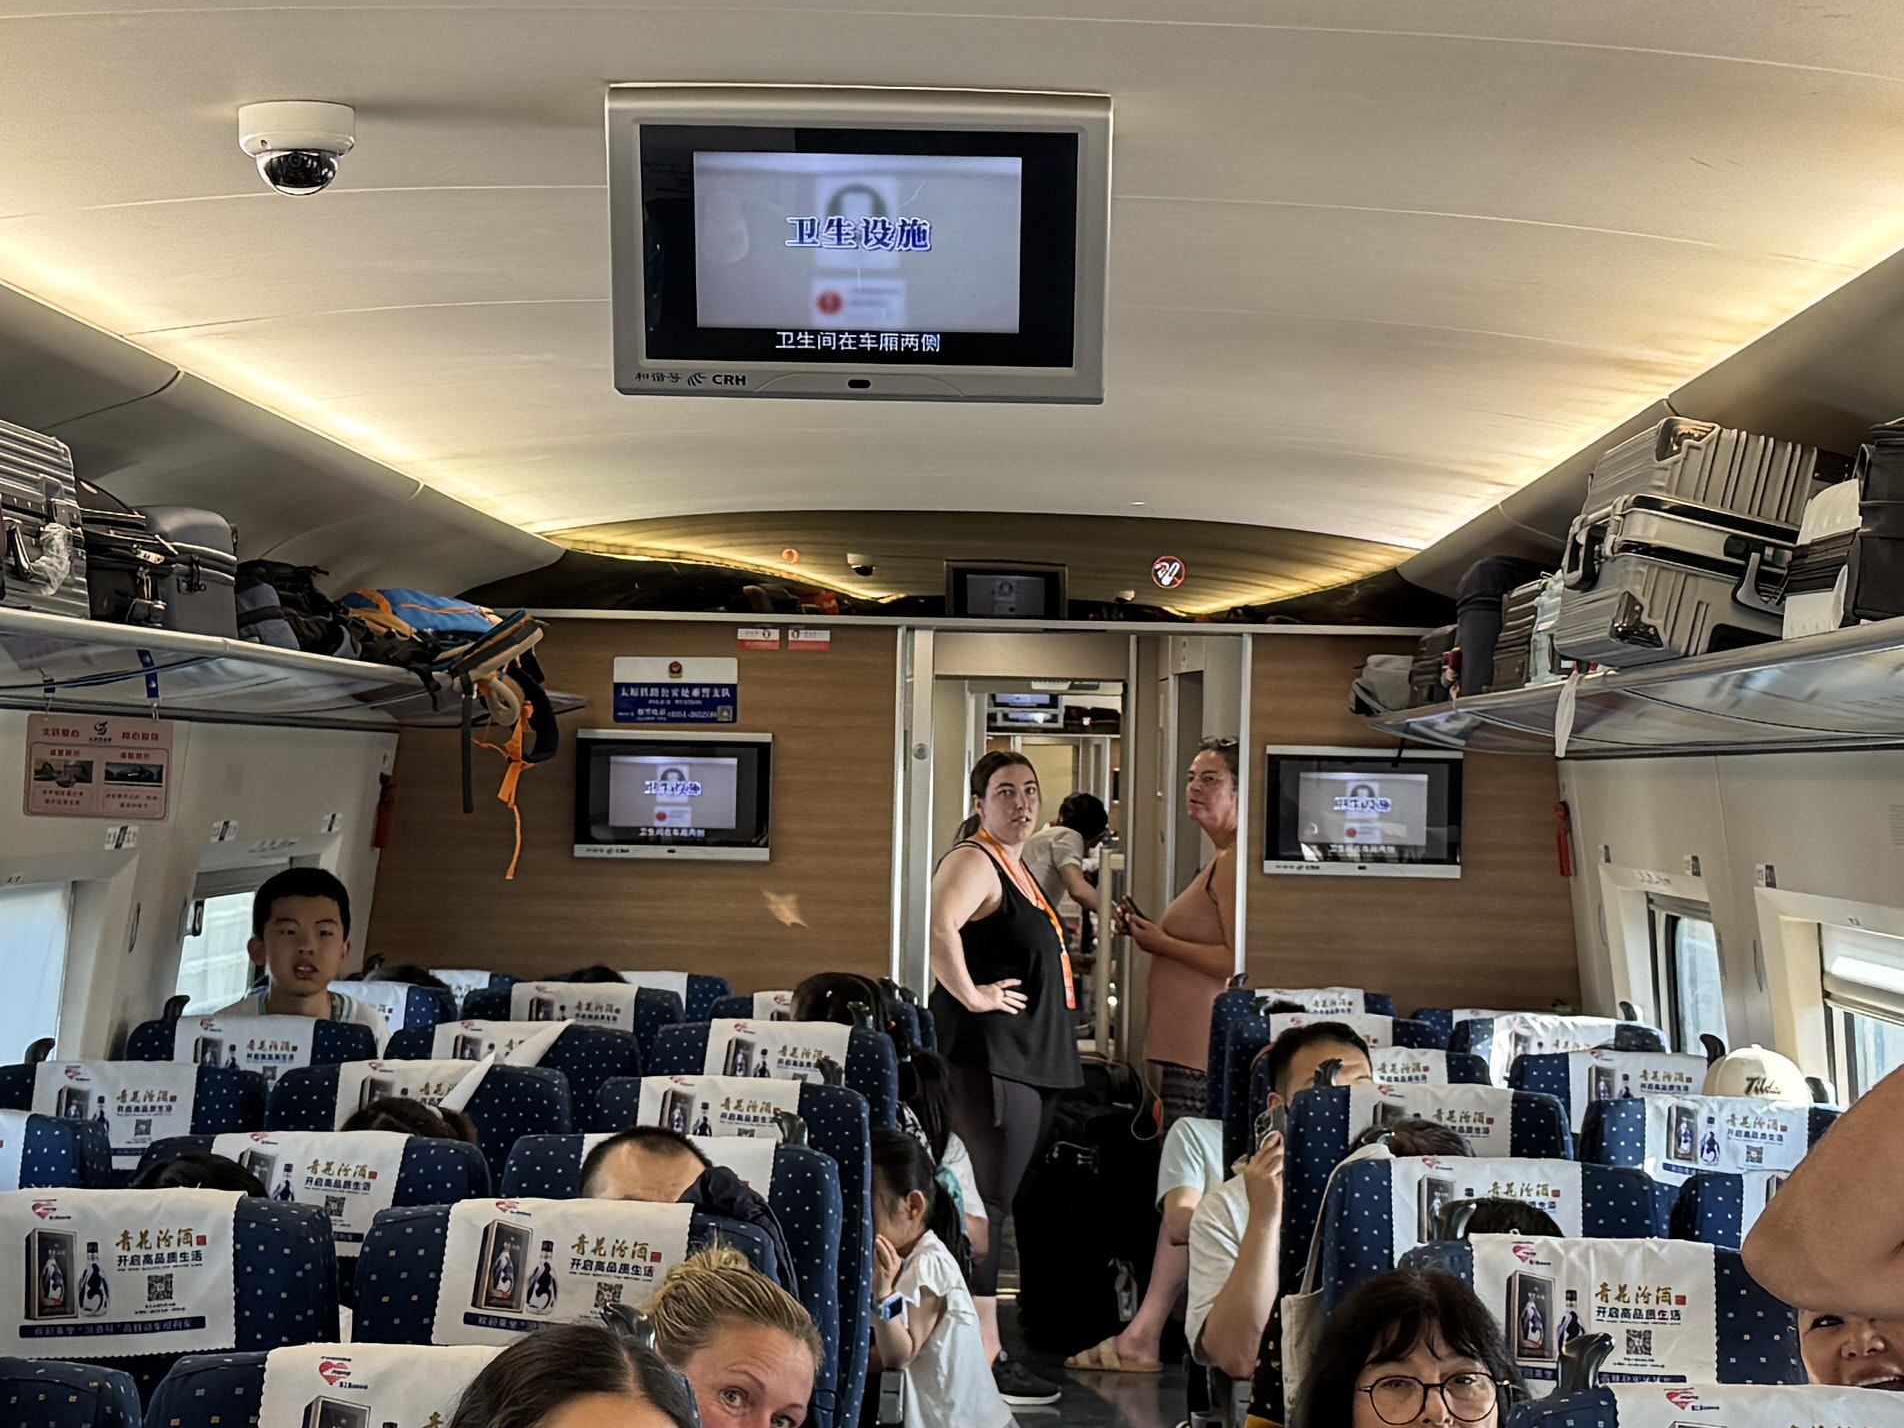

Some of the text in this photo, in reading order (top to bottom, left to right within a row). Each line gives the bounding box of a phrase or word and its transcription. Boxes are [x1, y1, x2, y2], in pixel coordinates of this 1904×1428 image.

[785, 216, 933, 252] 卫生设施
[775, 331, 941, 352] 卫生间在车厢两侧
[712, 374, 746, 386] CRH
